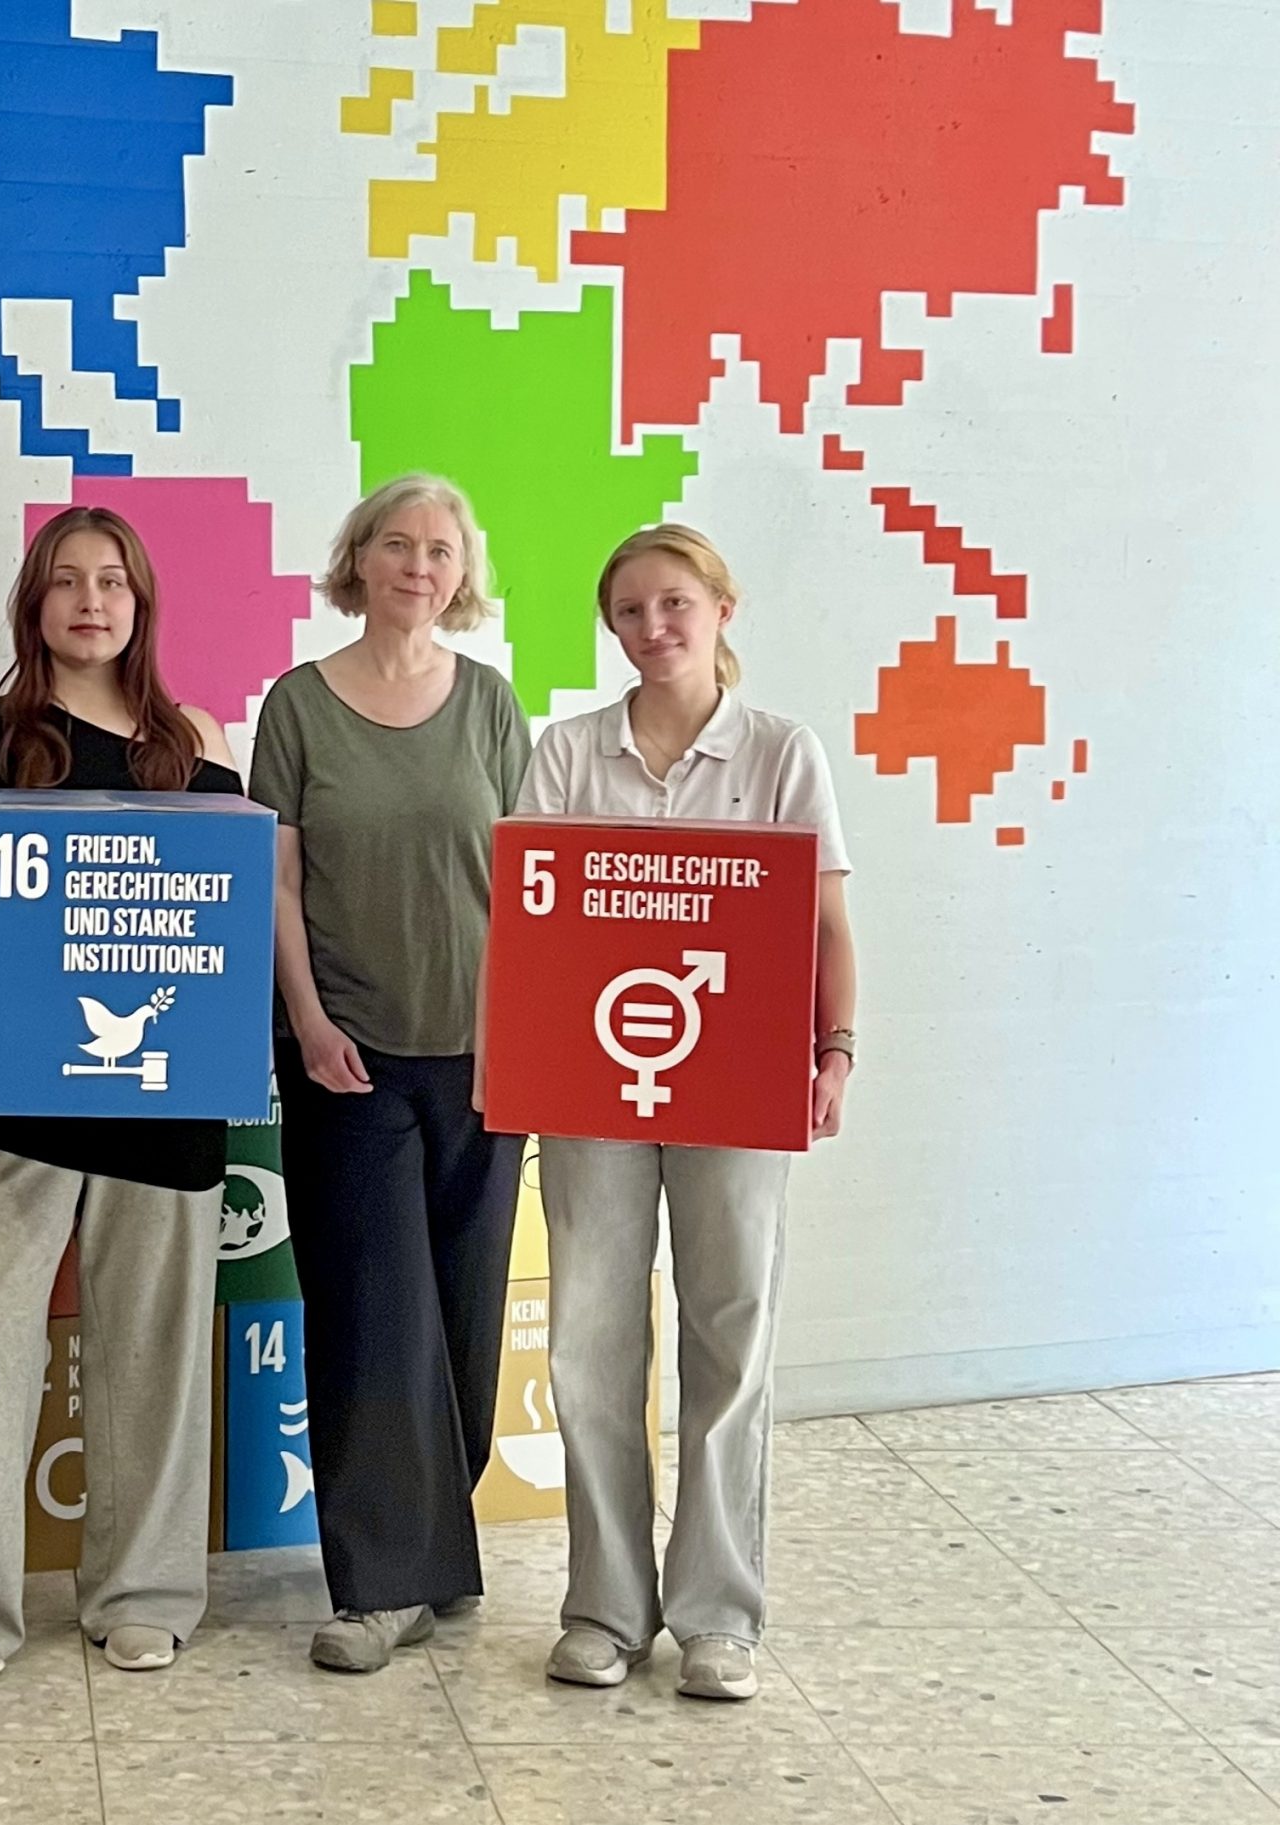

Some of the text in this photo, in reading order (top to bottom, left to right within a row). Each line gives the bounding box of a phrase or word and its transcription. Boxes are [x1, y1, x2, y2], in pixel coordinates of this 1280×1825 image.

[65, 834, 161, 867] FRIEDEN,
[522, 849, 556, 916] 5
[584, 851, 769, 888] GESCHLECHTER-
[65, 871, 233, 902] GERECHTIGKEIT
[583, 888, 714, 923] GLEICHHEIT
[64, 907, 197, 938] UND STARKE
[63, 943, 225, 975] INSTITUTIONEN
[511, 1299, 546, 1323] KEIN
[245, 1320, 287, 1375] 14
